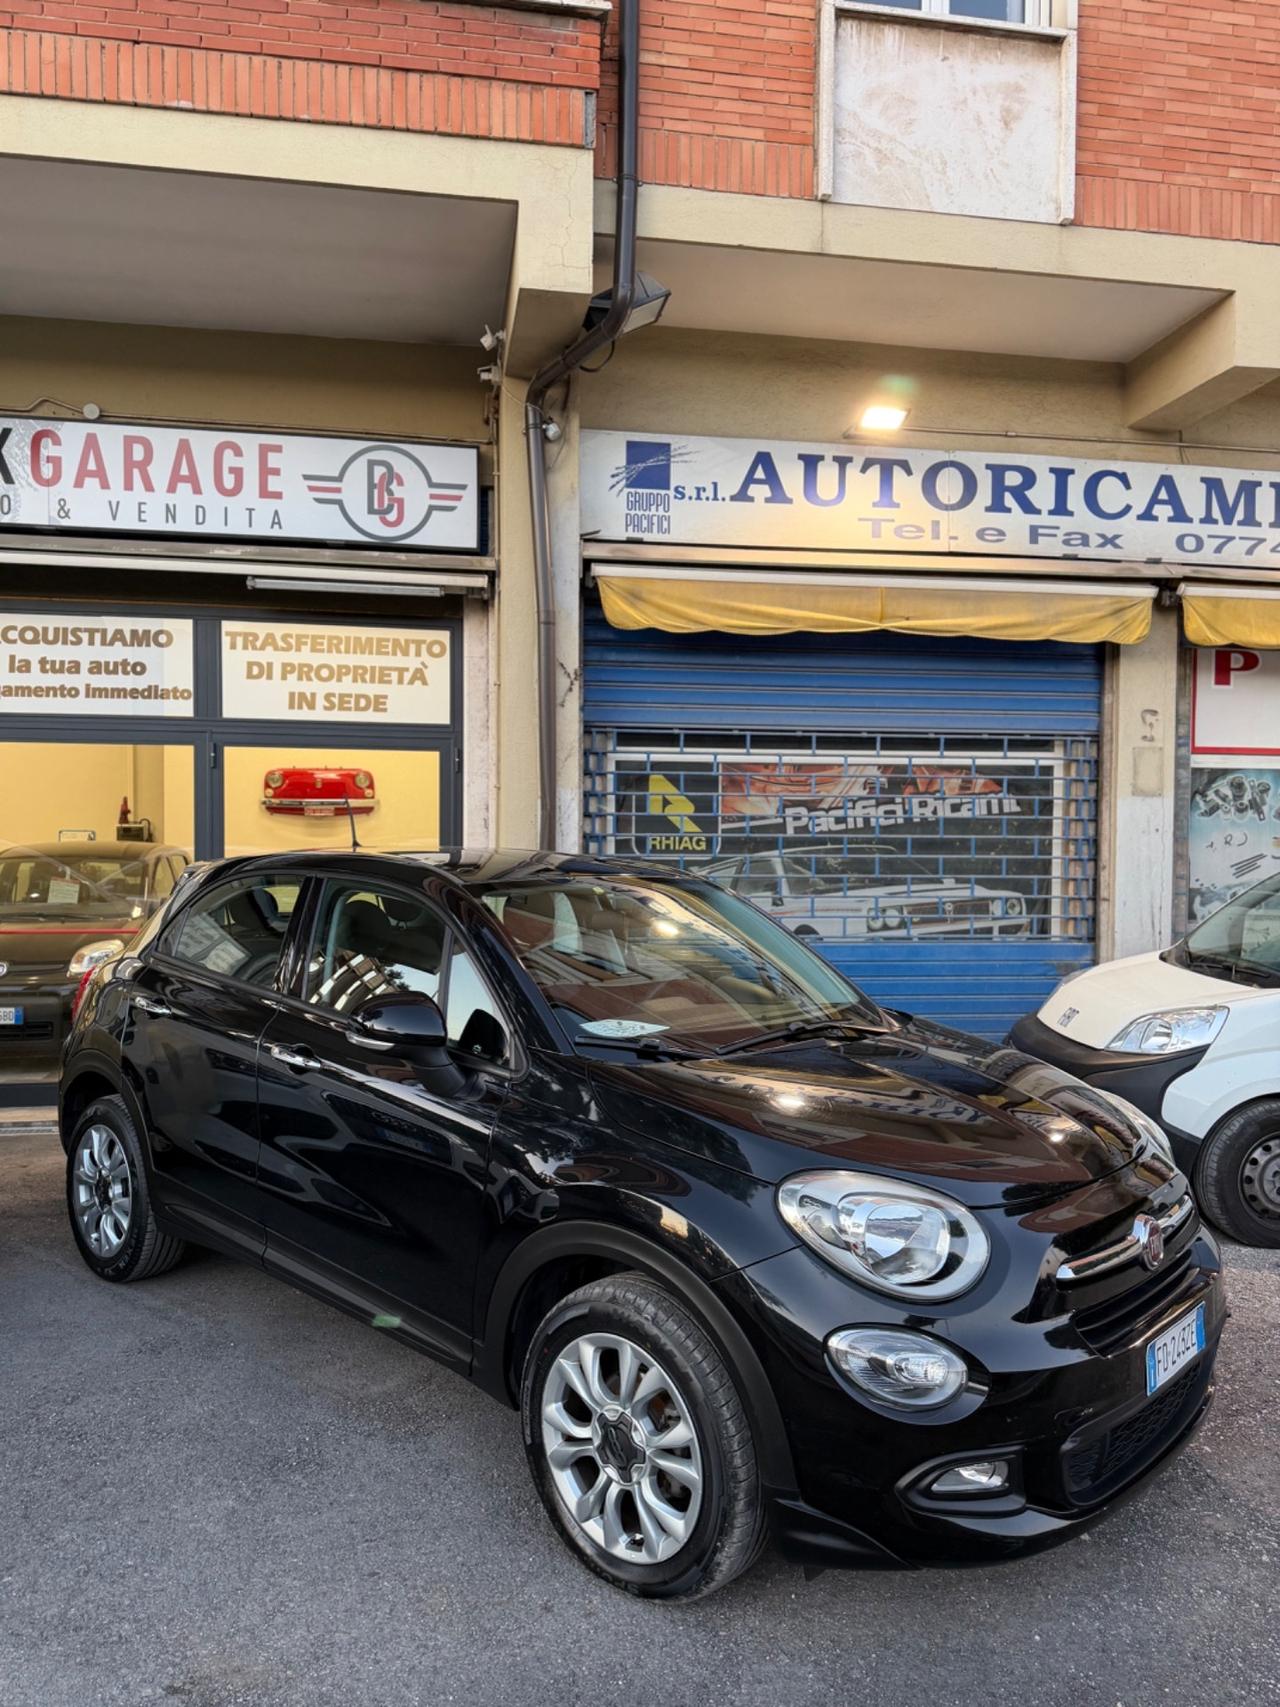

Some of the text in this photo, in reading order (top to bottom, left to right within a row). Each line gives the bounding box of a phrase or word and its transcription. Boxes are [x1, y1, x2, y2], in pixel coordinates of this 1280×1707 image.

[30, 428, 284, 500] GARAGE
[626, 491, 670, 513] GRUPPO
[673, 481, 726, 501] s.r.l.
[57, 498, 71, 519] &
[108, 500, 283, 530] VENDITA
[625, 513, 671, 534] PACIFICI
[858, 517, 958, 541] Tel.
[975, 526, 1007, 543] e
[1029, 524, 1124, 549] Fax
[0, 625, 174, 648] CQUISTIAMO
[225, 631, 447, 658] TRASFERIMENTO
[8, 654, 147, 676] la tua auto
[246, 661, 428, 686] DI PROPRIETÀ
[0, 683, 192, 700] amento immediato
[288, 691, 388, 712] IN SEDE
[648, 836, 707, 851] RHIAG
